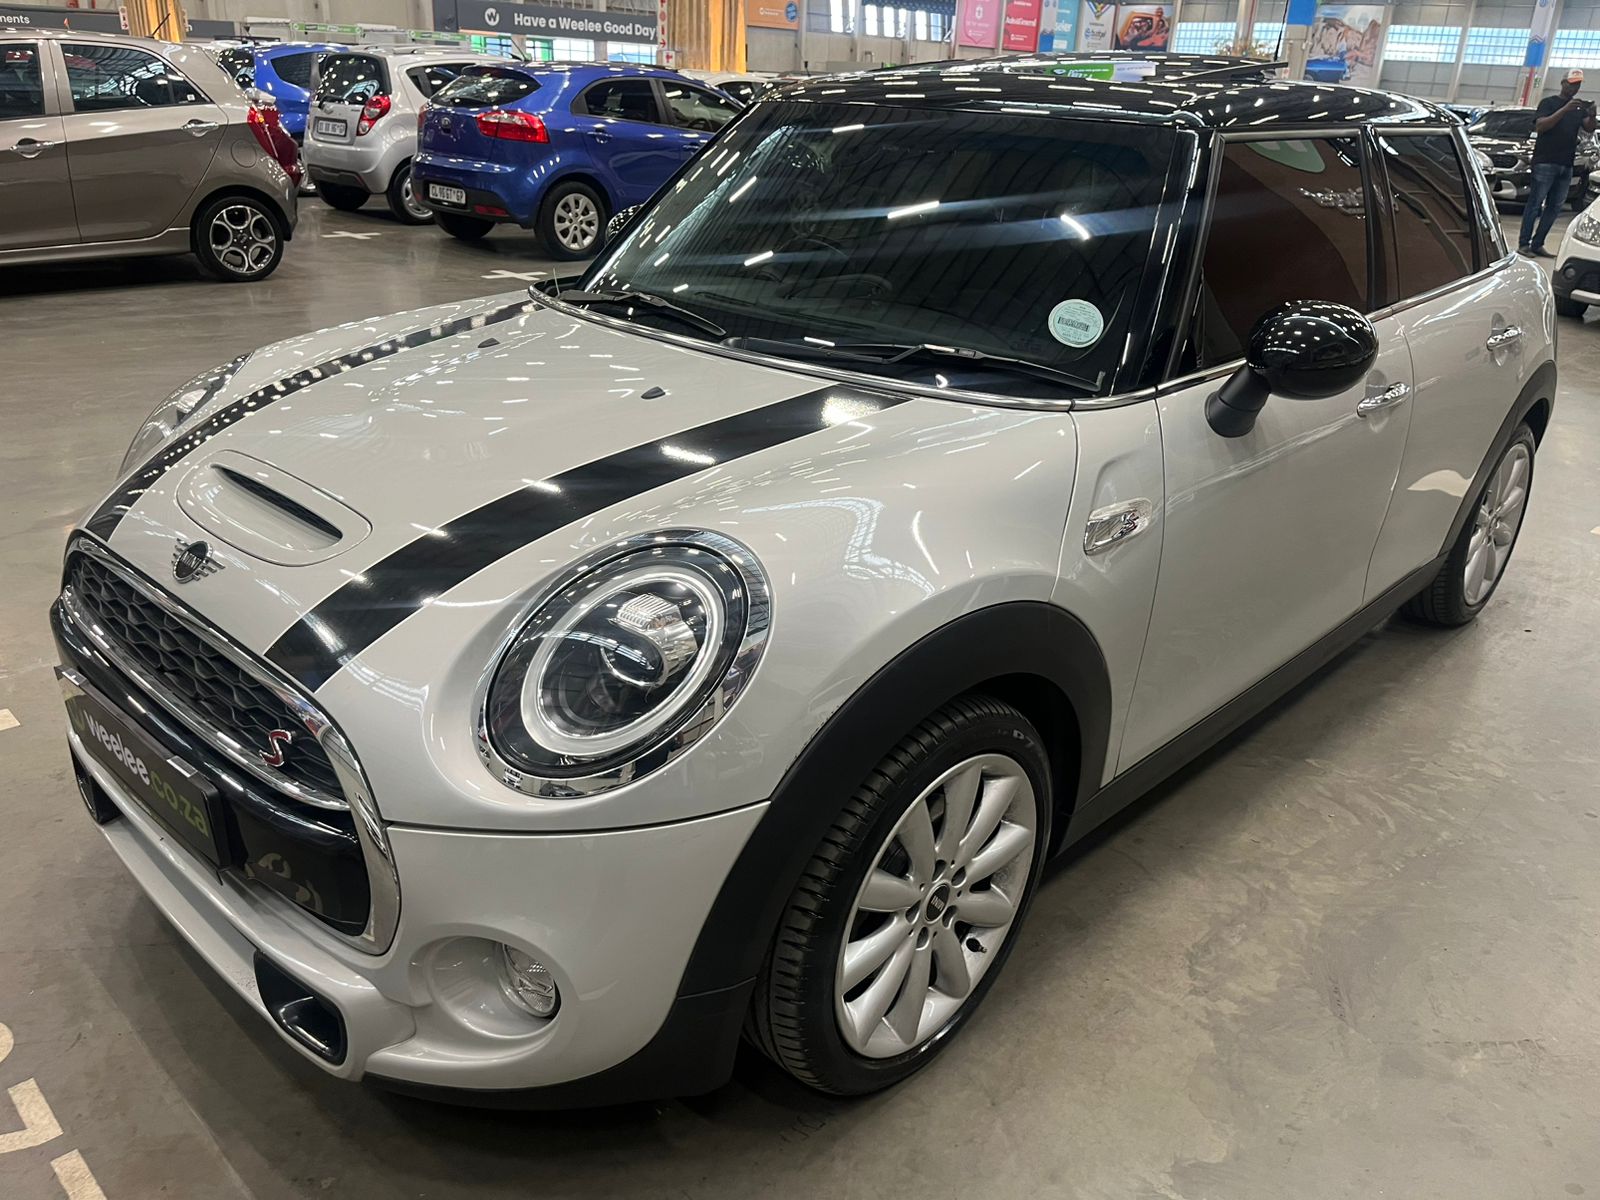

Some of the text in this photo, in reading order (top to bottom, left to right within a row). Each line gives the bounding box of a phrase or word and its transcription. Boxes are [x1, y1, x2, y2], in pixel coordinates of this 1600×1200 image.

[514, 13, 547, 28] Have
[548, 18, 557, 28] a
[558, 16, 602, 32] Weelee
[603, 22, 633, 35] Good
[259, 729, 292, 767] S
